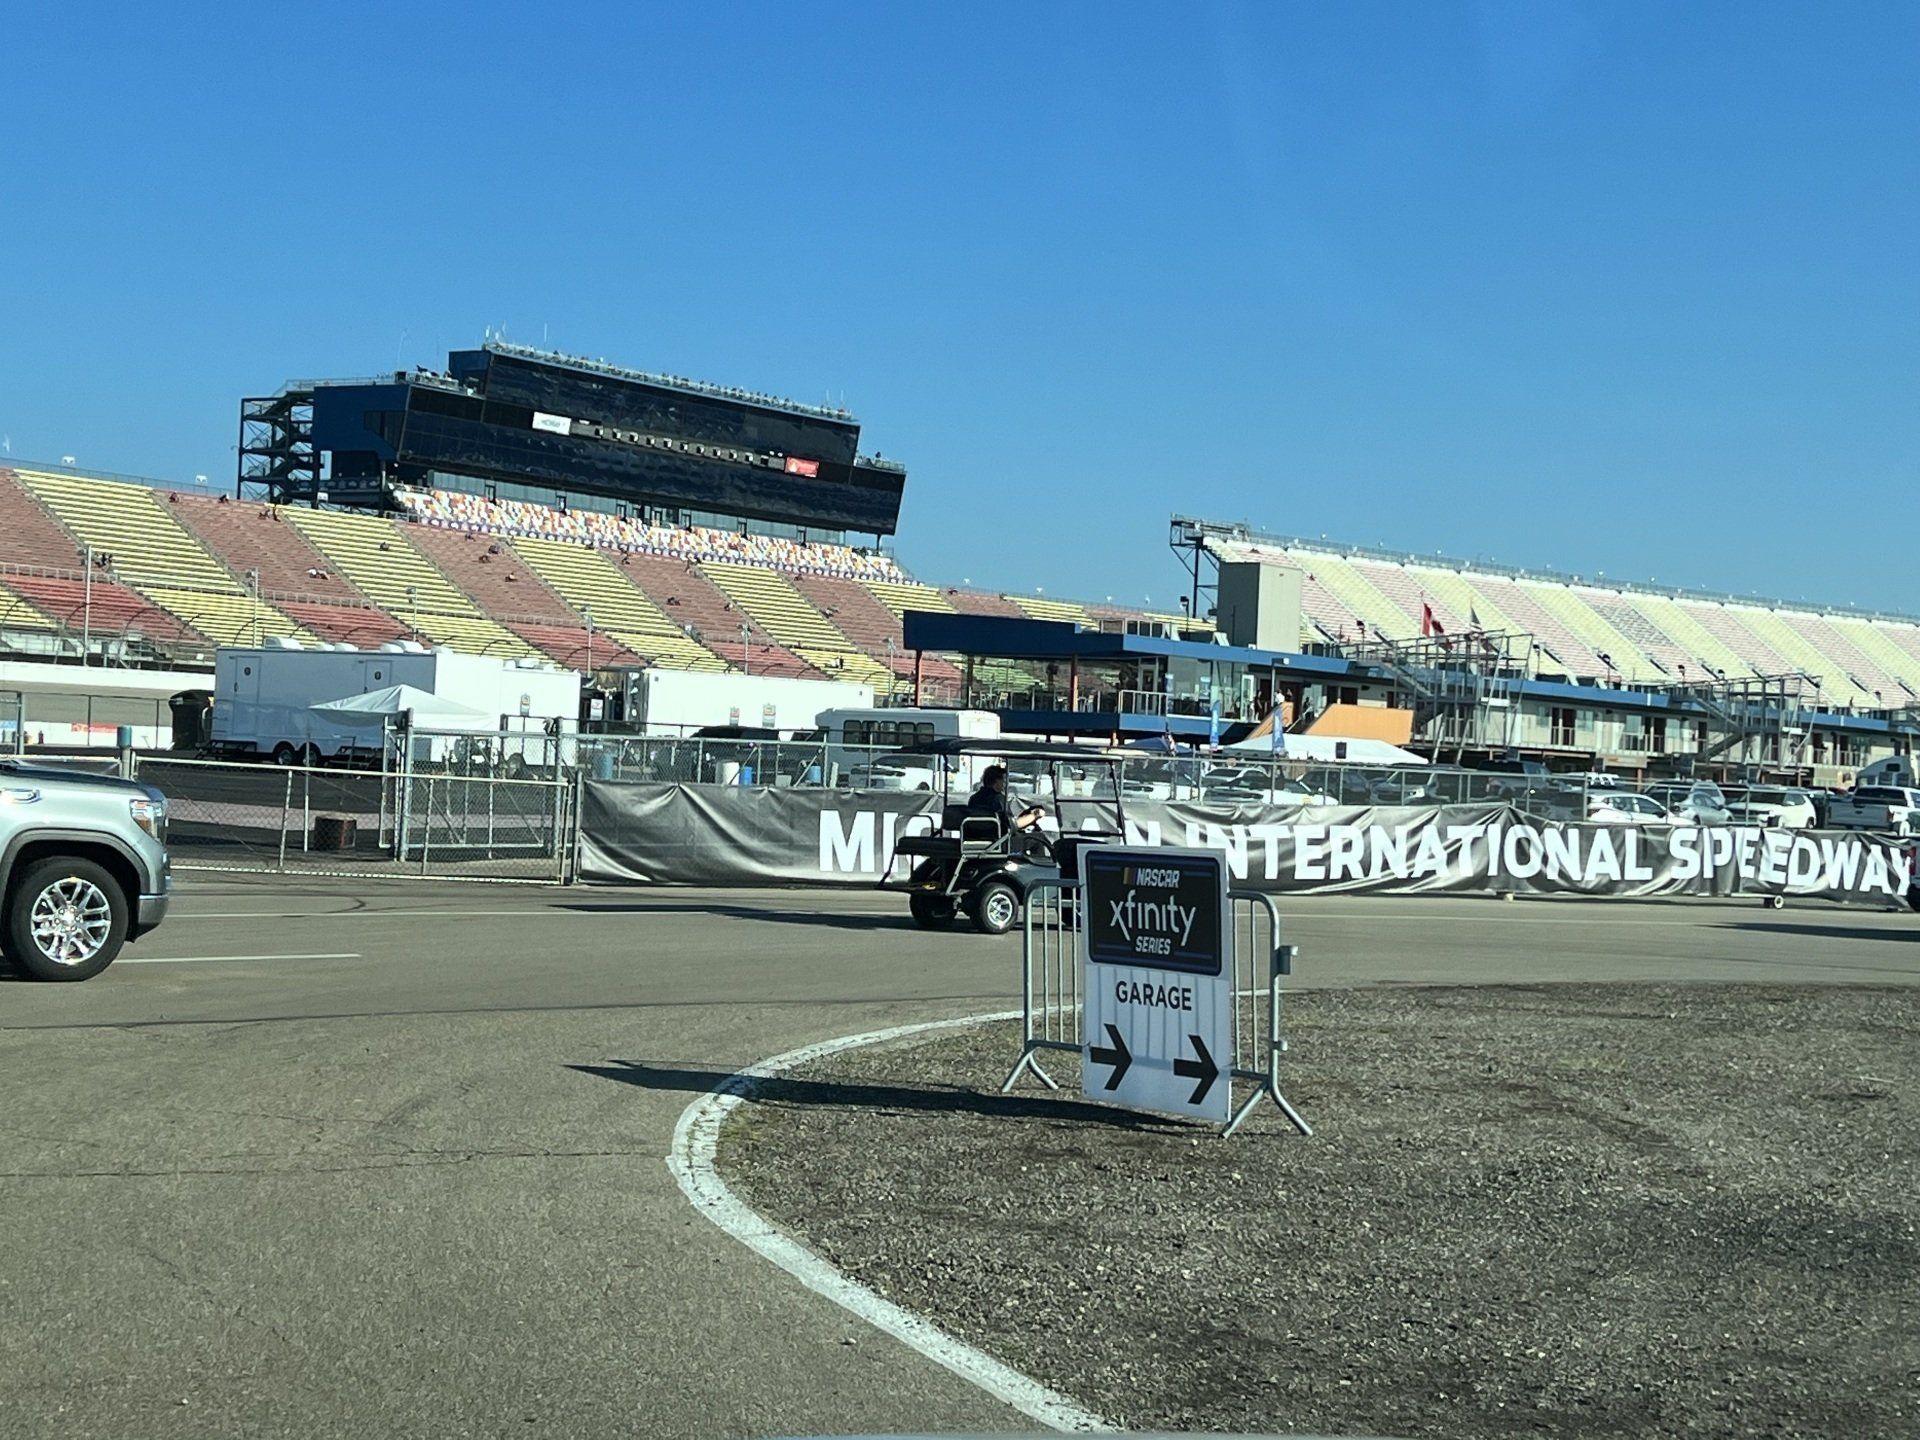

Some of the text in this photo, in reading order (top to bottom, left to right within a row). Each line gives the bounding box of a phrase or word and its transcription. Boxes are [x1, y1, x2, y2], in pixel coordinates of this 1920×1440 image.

[1669, 828, 1911, 896] SPEEDWAY
[1136, 868, 1180, 888] NASCAR
[1110, 889, 1196, 946] xfinity
[1135, 936, 1172, 955] SERIES
[1115, 980, 1192, 1011] GARAGE
